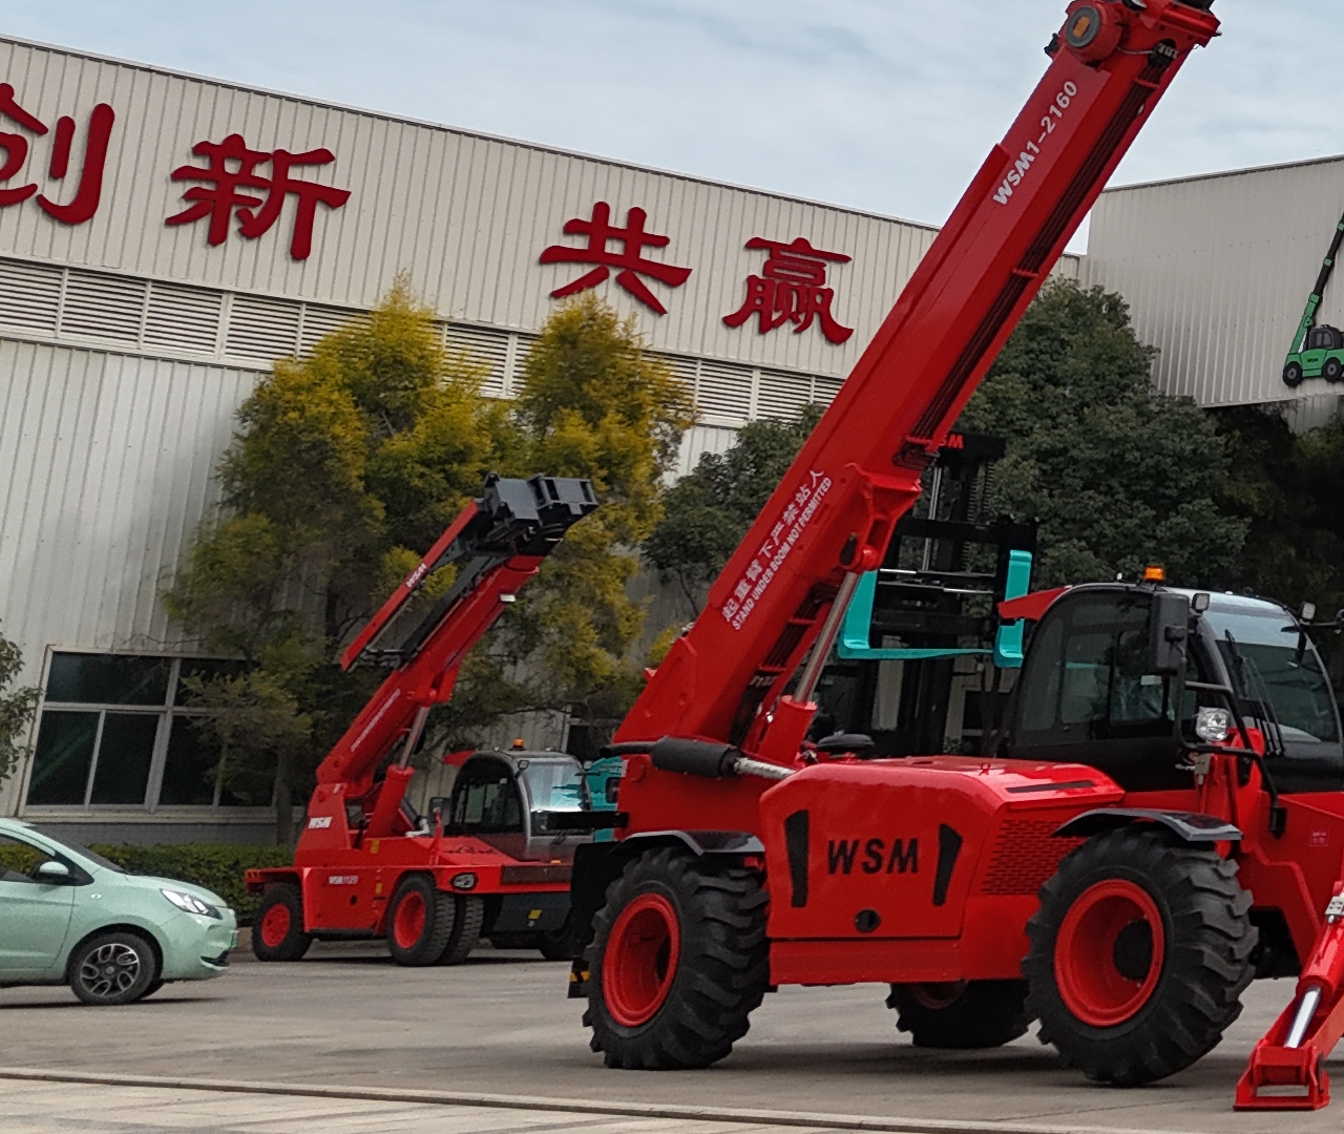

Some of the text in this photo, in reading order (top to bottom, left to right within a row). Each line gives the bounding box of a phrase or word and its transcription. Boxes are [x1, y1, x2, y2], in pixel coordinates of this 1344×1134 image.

[992, 81, 1078, 206] WSM1-2160
[0, 83, 855, 345] 创新 共赢
[732, 476, 833, 631] STAND UNDER BOOM NOT PERMITTED
[308, 816, 332, 829] WSM
[827, 838, 920, 875] WSM
